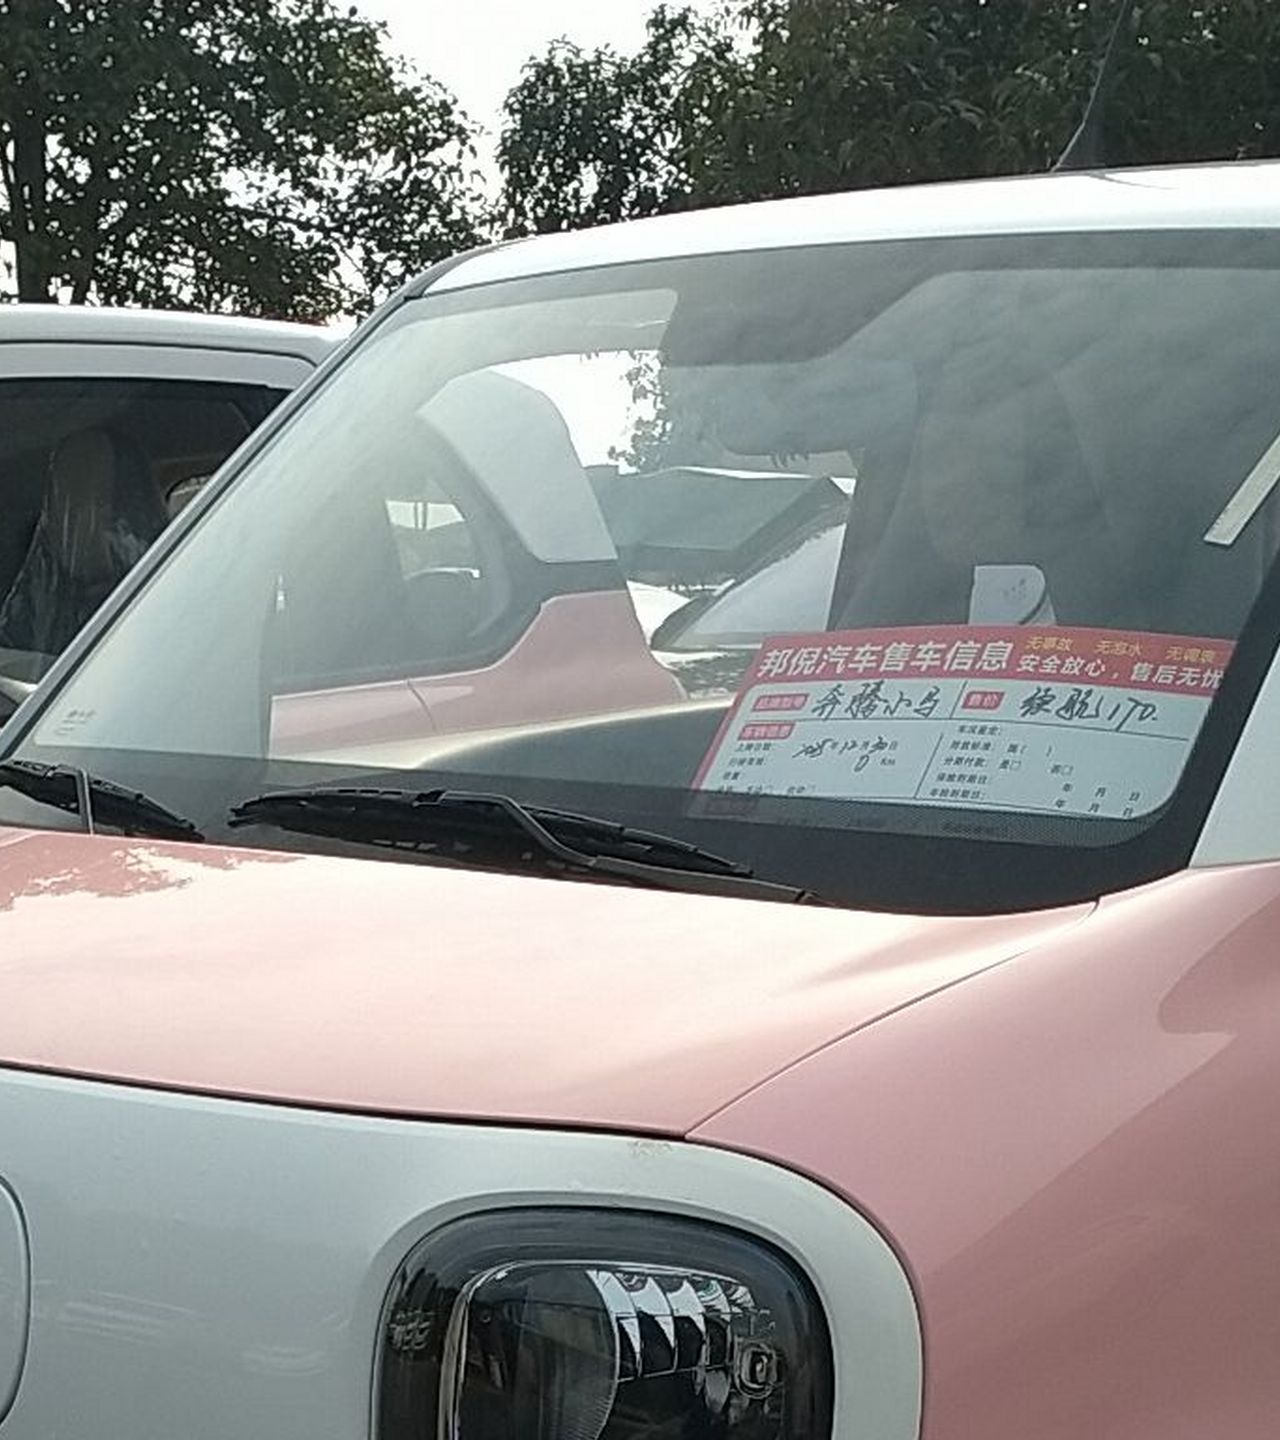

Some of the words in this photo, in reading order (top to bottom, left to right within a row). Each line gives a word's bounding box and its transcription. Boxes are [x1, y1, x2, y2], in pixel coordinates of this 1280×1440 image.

[757, 640, 1012, 678] 邦倪汽车售车信息
